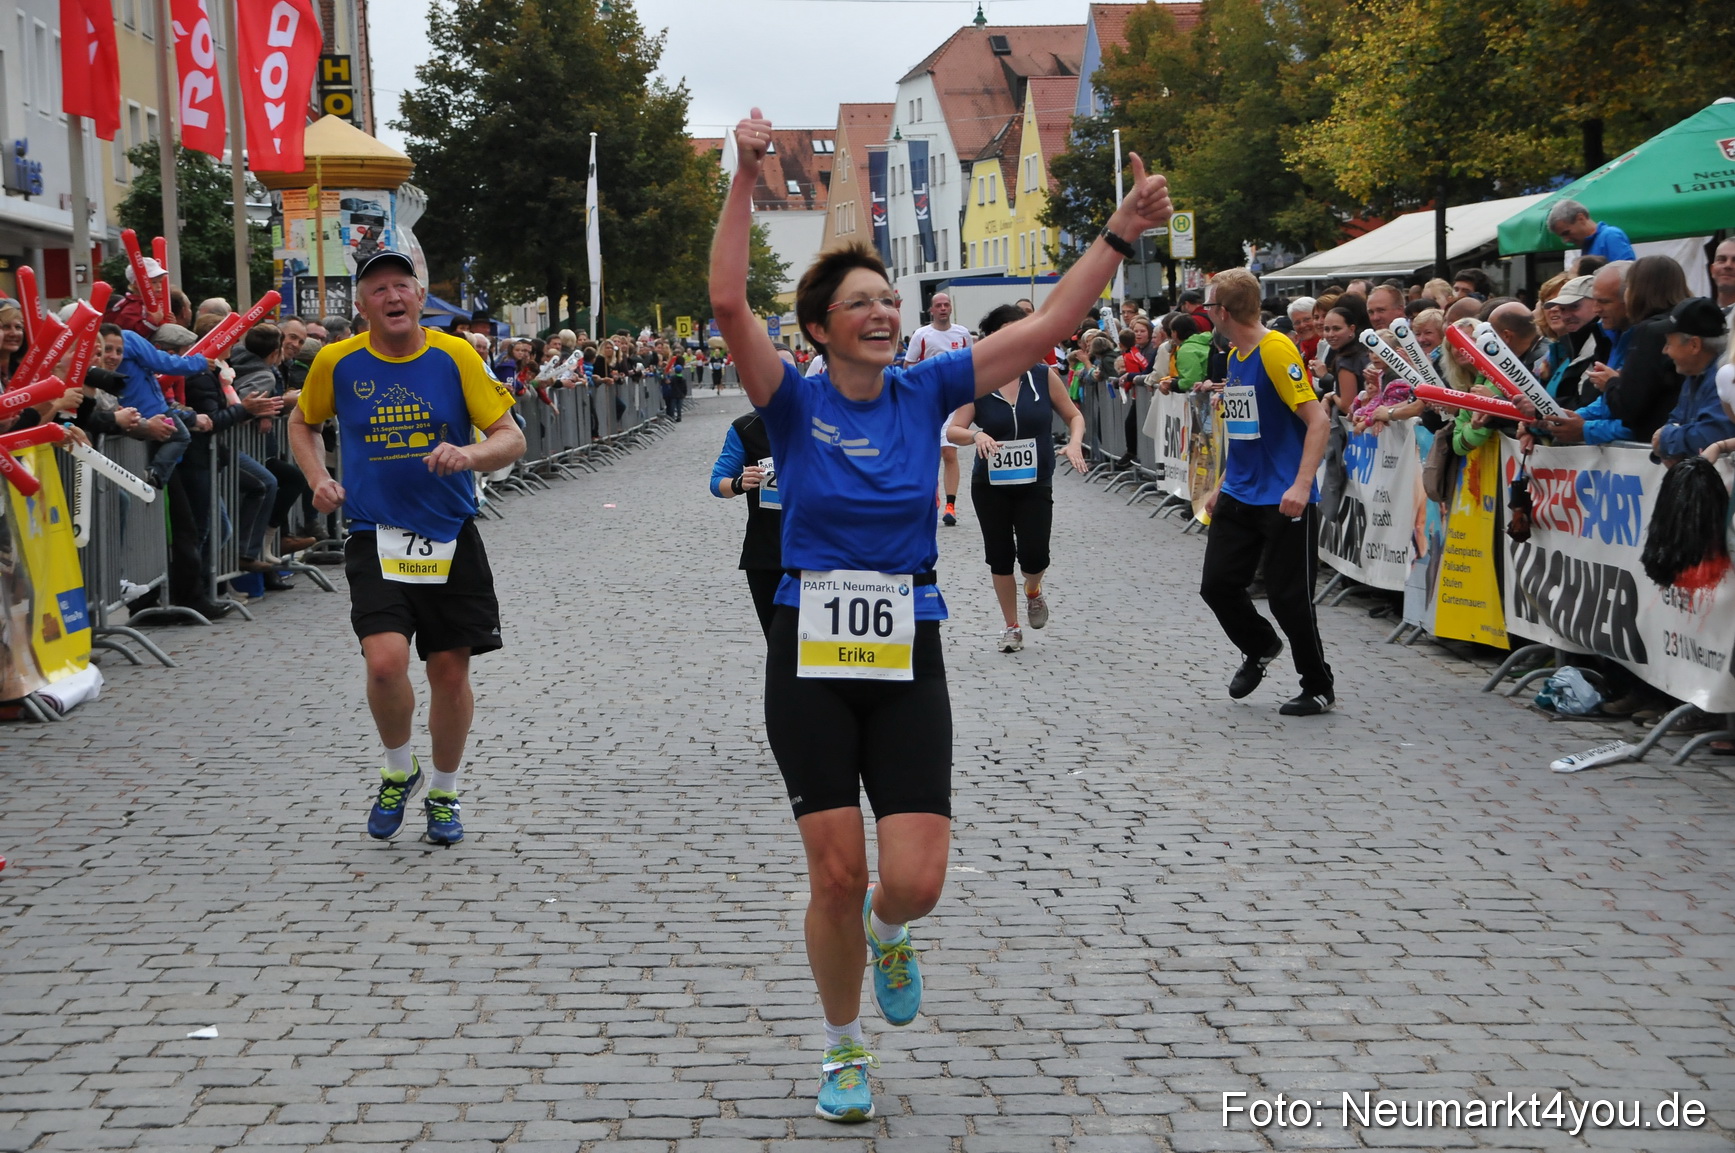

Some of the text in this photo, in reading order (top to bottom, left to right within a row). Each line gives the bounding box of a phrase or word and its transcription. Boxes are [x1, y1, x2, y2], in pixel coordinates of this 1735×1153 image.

[216, 322, 246, 350] Audi BKK
[71, 339, 90, 383] Audi BKK
[1380, 347, 1408, 373] BMW
[1499, 357, 1530, 387] BMW
[993, 450, 1033, 469] 3409
[402, 532, 433, 557] 73
[398, 562, 438, 573] Richard
[803, 581, 895, 593] PARTL Neumarkt
[823, 596, 894, 638] 106
[838, 646, 875, 663] Erika
